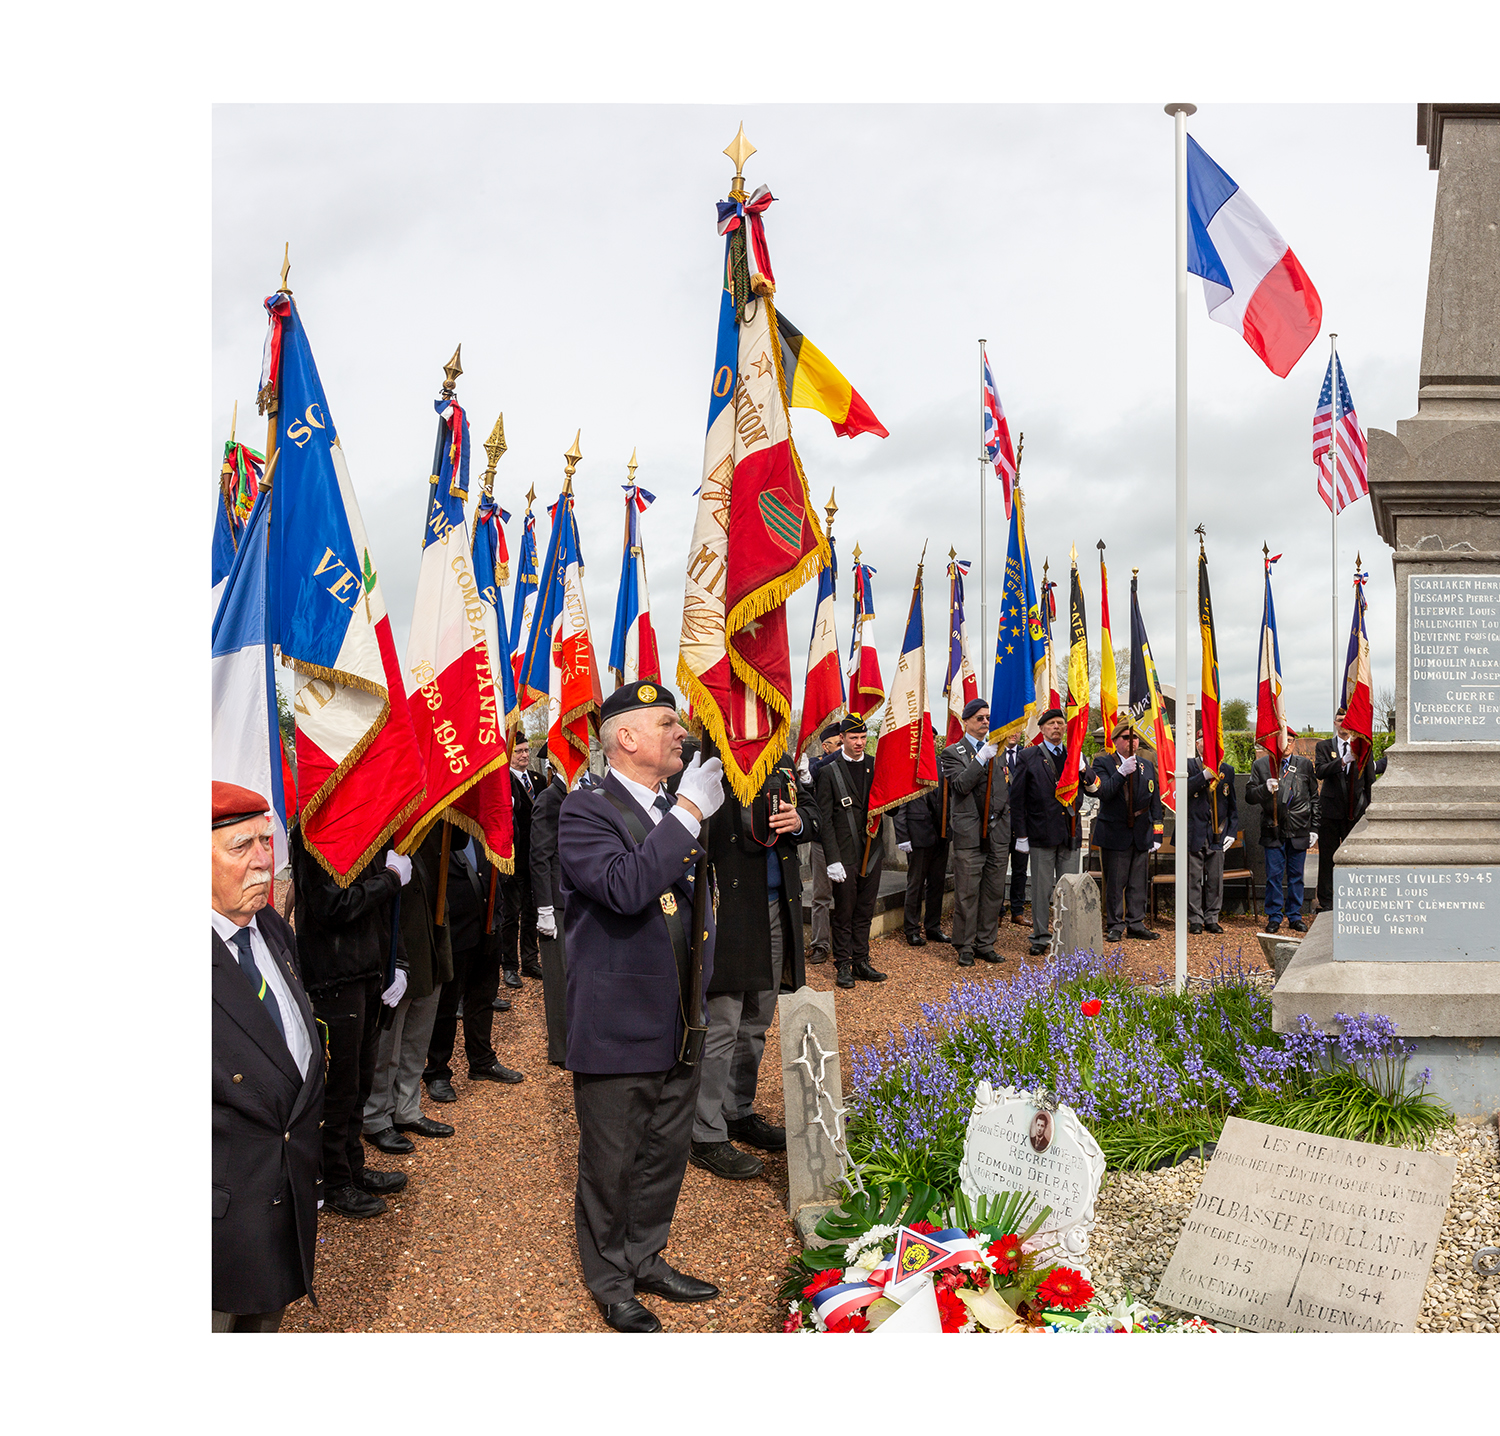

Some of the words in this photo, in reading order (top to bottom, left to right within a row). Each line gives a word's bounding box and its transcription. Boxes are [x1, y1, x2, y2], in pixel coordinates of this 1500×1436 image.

[1006, 580, 1017, 591] ET
[1413, 578, 1472, 590] SCARLAKEN
[1413, 592, 1464, 603] DESCAMPS
[1413, 605, 1465, 616] LEFEBVRE
[1469, 606, 1496, 616] LOUIS
[564, 578, 590, 676] NATIONALE
[1413, 618, 1478, 629] BALLENGHIEN
[1413, 630, 1461, 642] DEVIENNE
[451, 556, 497, 745] COMBATTANTS
[1413, 643, 1459, 655] BLEUZET
[1463, 645, 1490, 655] OMER
[1413, 656, 1467, 668] DUMOULIN
[1413, 669, 1467, 681] DUMOULIN
[1446, 690, 1495, 701] GUERRE
[1413, 702, 1473, 713] VERBECKE
[905, 690, 919, 760] MUNICIPALE
[1413, 714, 1486, 725] GRIMONPREZ
[1348, 873, 1401, 884] VICTIMES
[1407, 873, 1451, 884] CIVILES
[1454, 872, 1493, 884] 39-45
[1337, 885, 1387, 897] GRARRE
[1396, 887, 1429, 897] LOUIS
[1337, 898, 1414, 911] LACQUEMENT
[1418, 898, 1486, 910] CLÉMENTINE
[1337, 911, 1374, 924] BOUCQ
[1384, 913, 1428, 923] GASTON
[1337, 923, 1381, 935] DURIEU
[1390, 925, 1425, 935] HENRI
[1262, 1134, 1291, 1153] LES
[977, 1151, 1022, 1177] EDMOND
[1270, 1186, 1315, 1207] LEURS
[1319, 1195, 1406, 1224] CAMARADES
[1195, 1193, 1298, 1233] DELBASSEE
[1212, 1252, 1254, 1275] 1945
[1337, 1282, 1386, 1306] 1944
